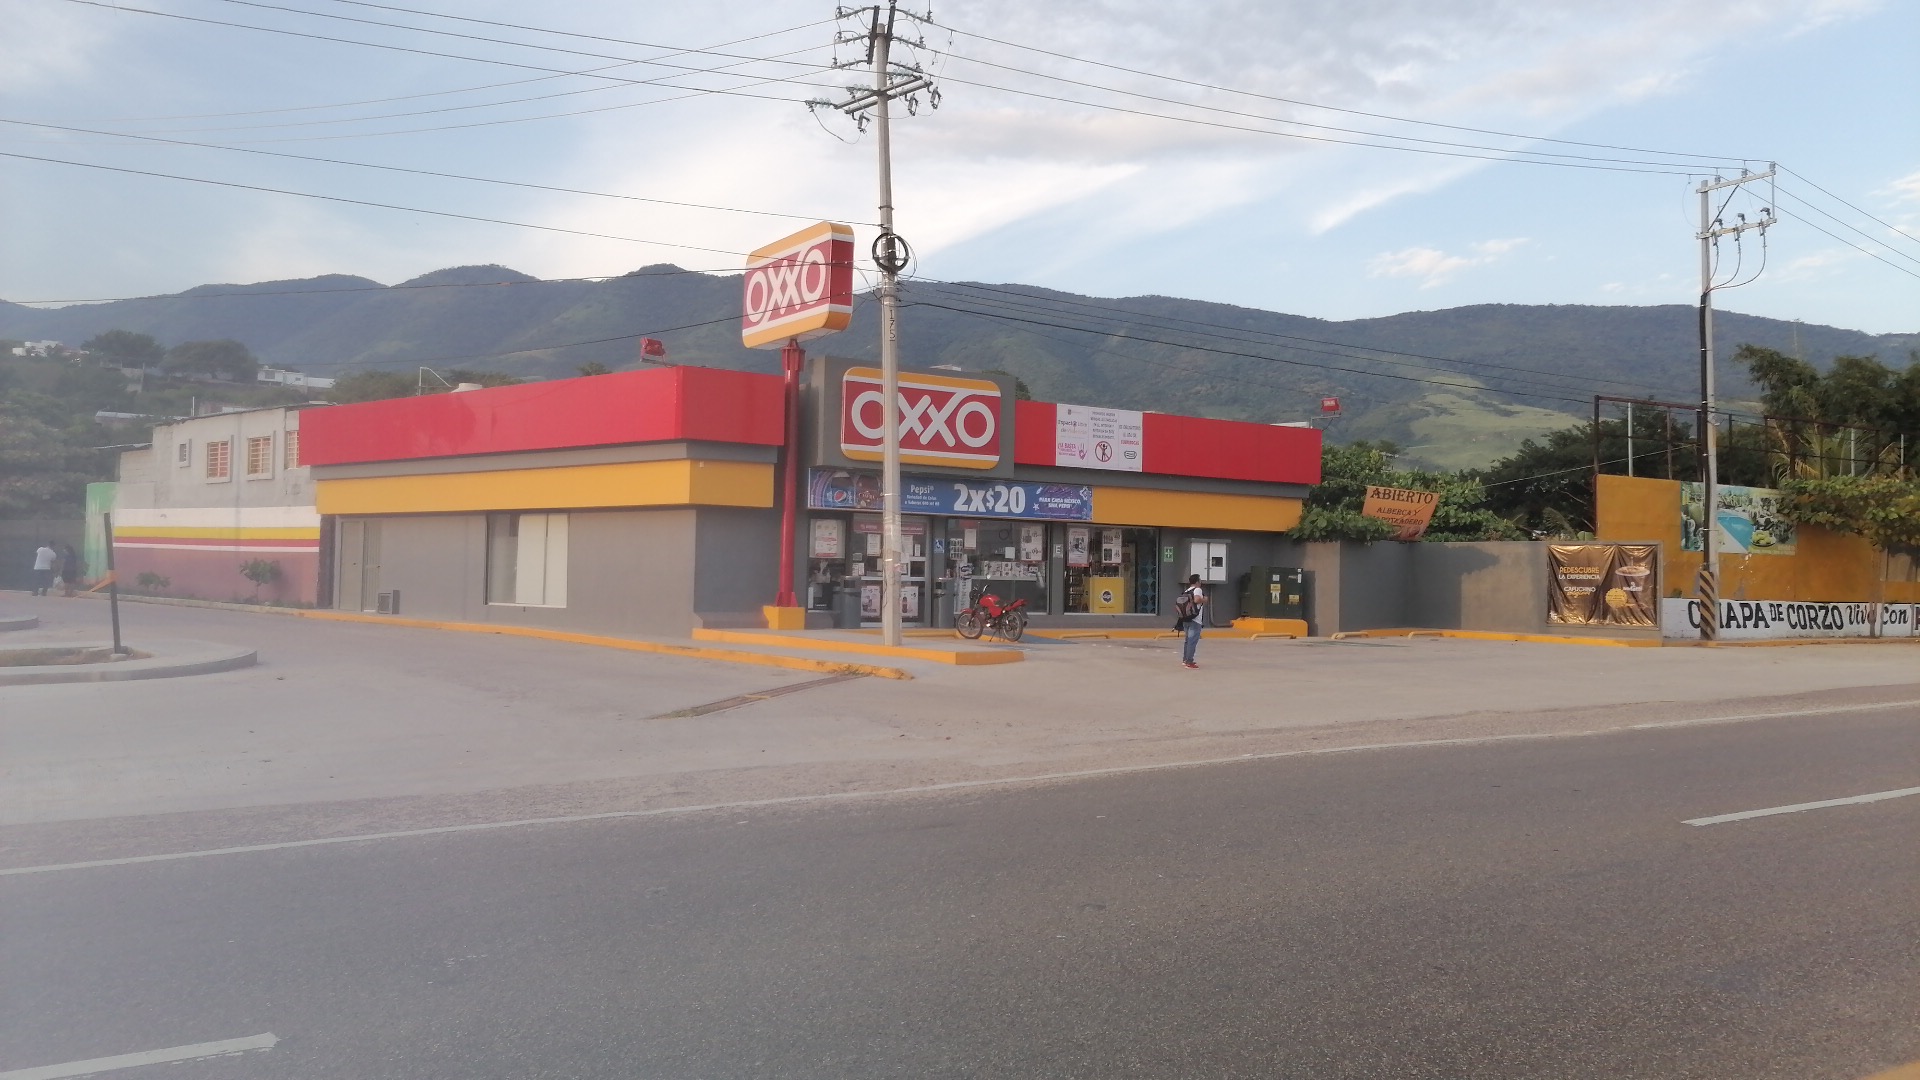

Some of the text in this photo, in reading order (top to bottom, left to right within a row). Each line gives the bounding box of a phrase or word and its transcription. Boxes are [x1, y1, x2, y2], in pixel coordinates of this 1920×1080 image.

[746, 248, 827, 323] OXXO
[851, 390, 996, 448] OXXO
[1370, 488, 1433, 504] ABIERTO
[1376, 507, 1411, 516] ALBERCA
[1559, 566, 1600, 574] REDESCUBRE
[1688, 600, 1771, 630] CIAPA
[1770, 603, 1785, 622] DE
[1786, 603, 1845, 631] CORZO
